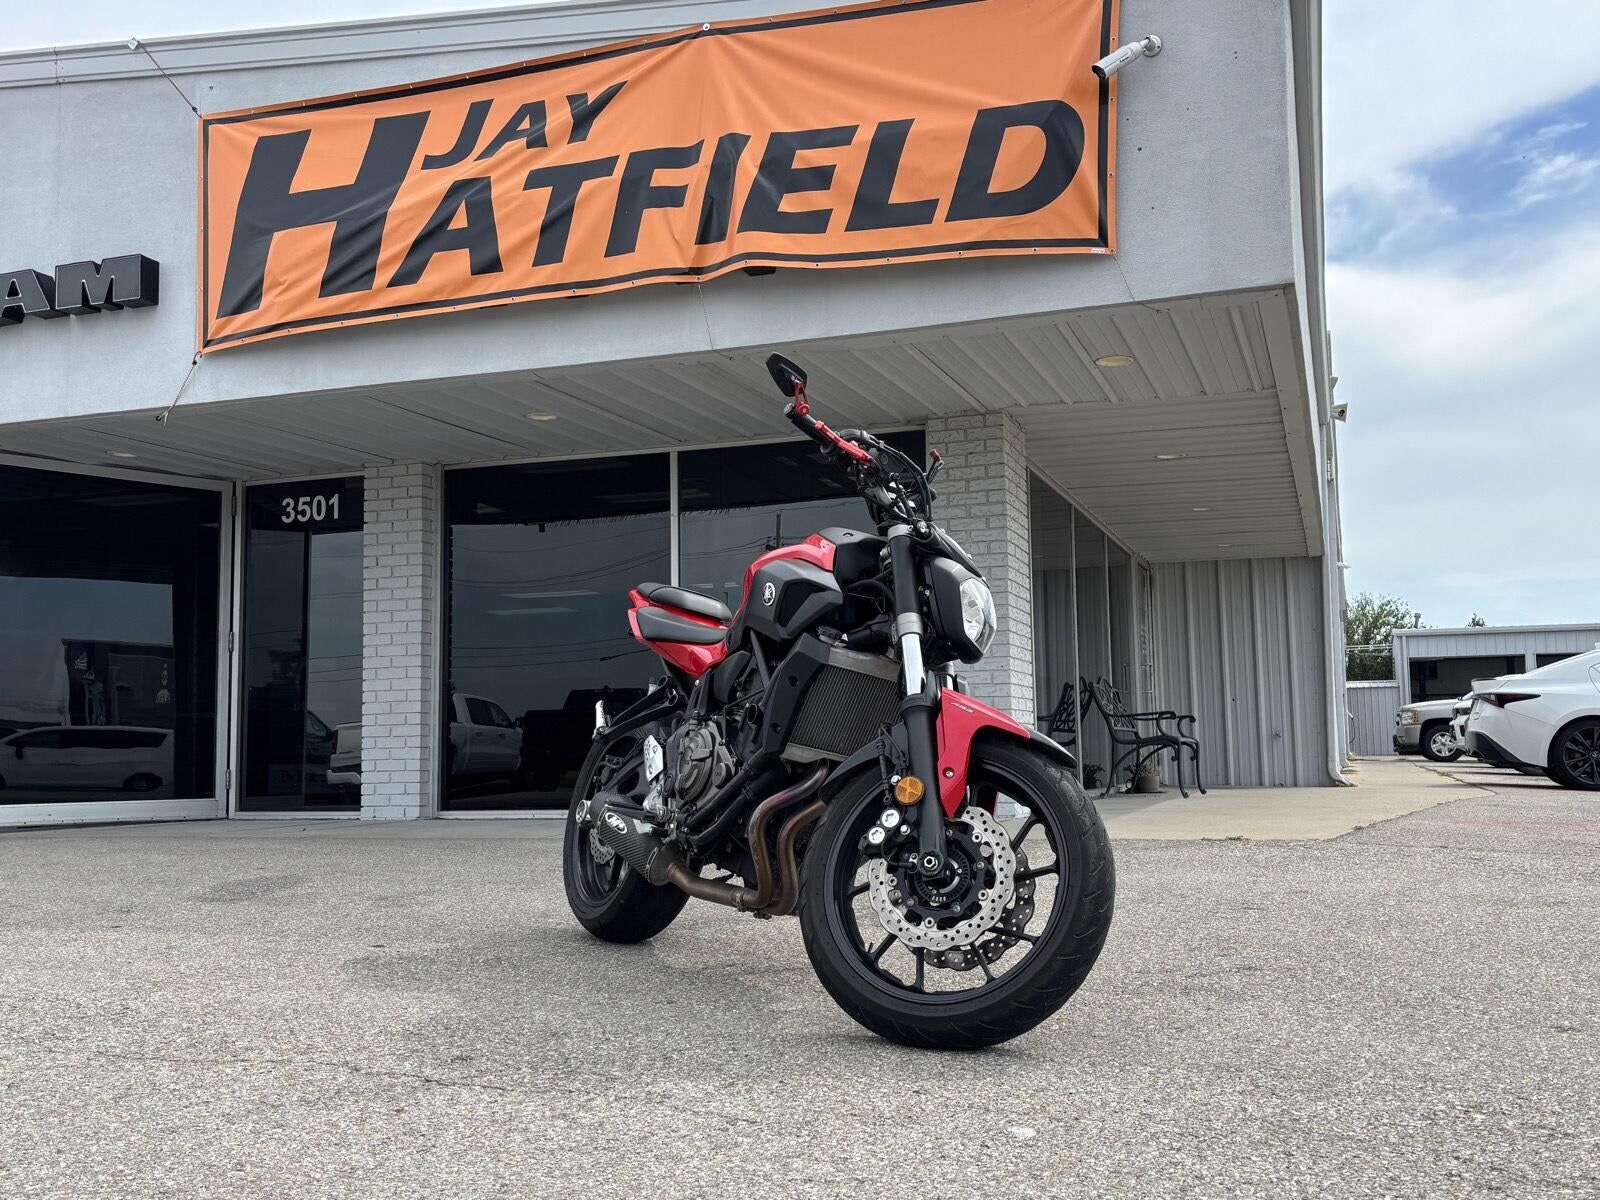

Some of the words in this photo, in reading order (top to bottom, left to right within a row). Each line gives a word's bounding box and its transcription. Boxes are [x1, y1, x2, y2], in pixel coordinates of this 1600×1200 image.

[421, 81, 627, 170] JAY
[216, 100, 1084, 319] HATFIELD
[281, 493, 339, 523] 3501
